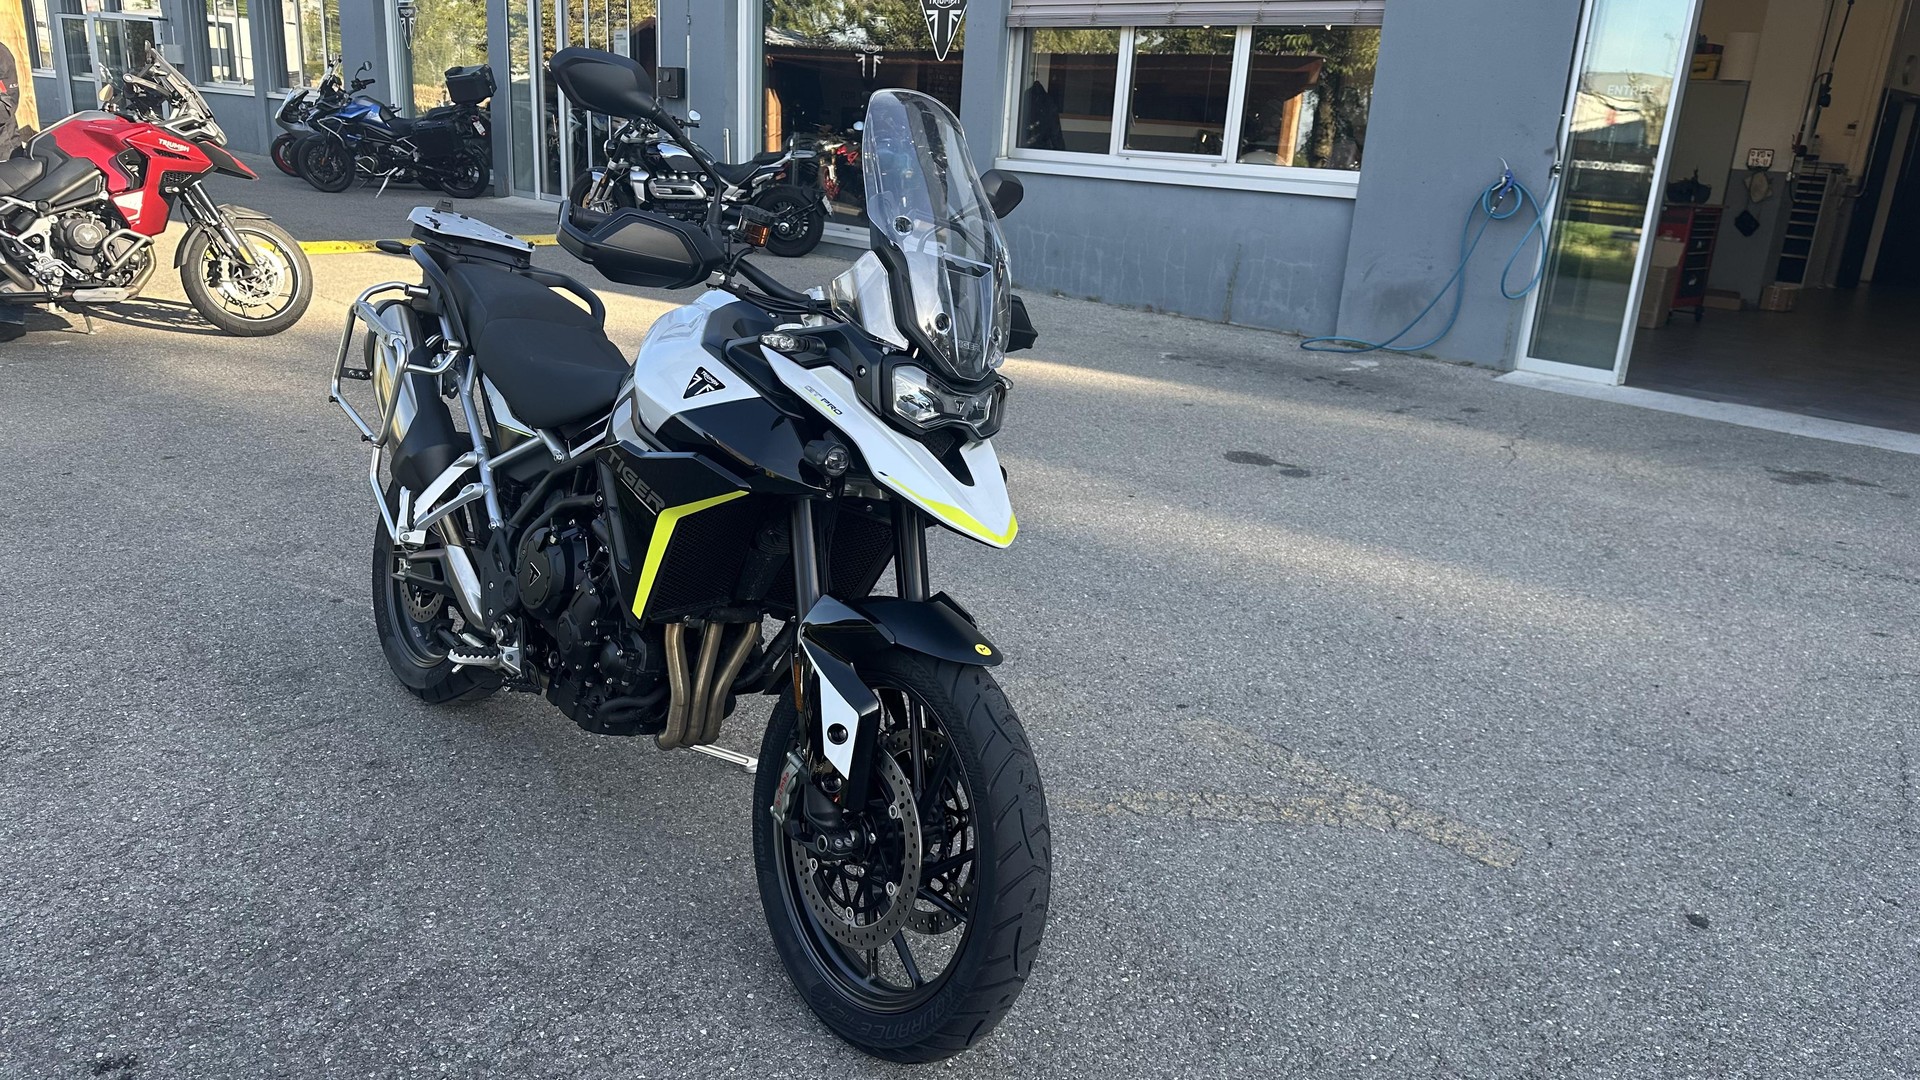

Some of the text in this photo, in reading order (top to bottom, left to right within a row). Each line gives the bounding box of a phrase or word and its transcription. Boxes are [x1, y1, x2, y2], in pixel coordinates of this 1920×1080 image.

[158, 138, 190, 153] TRIUMPH
[701, 370, 720, 386] TRIUMPH
[804, 385, 843, 415] GT PRO
[607, 448, 666, 512] TIGER
[775, 771, 790, 807] brembo
